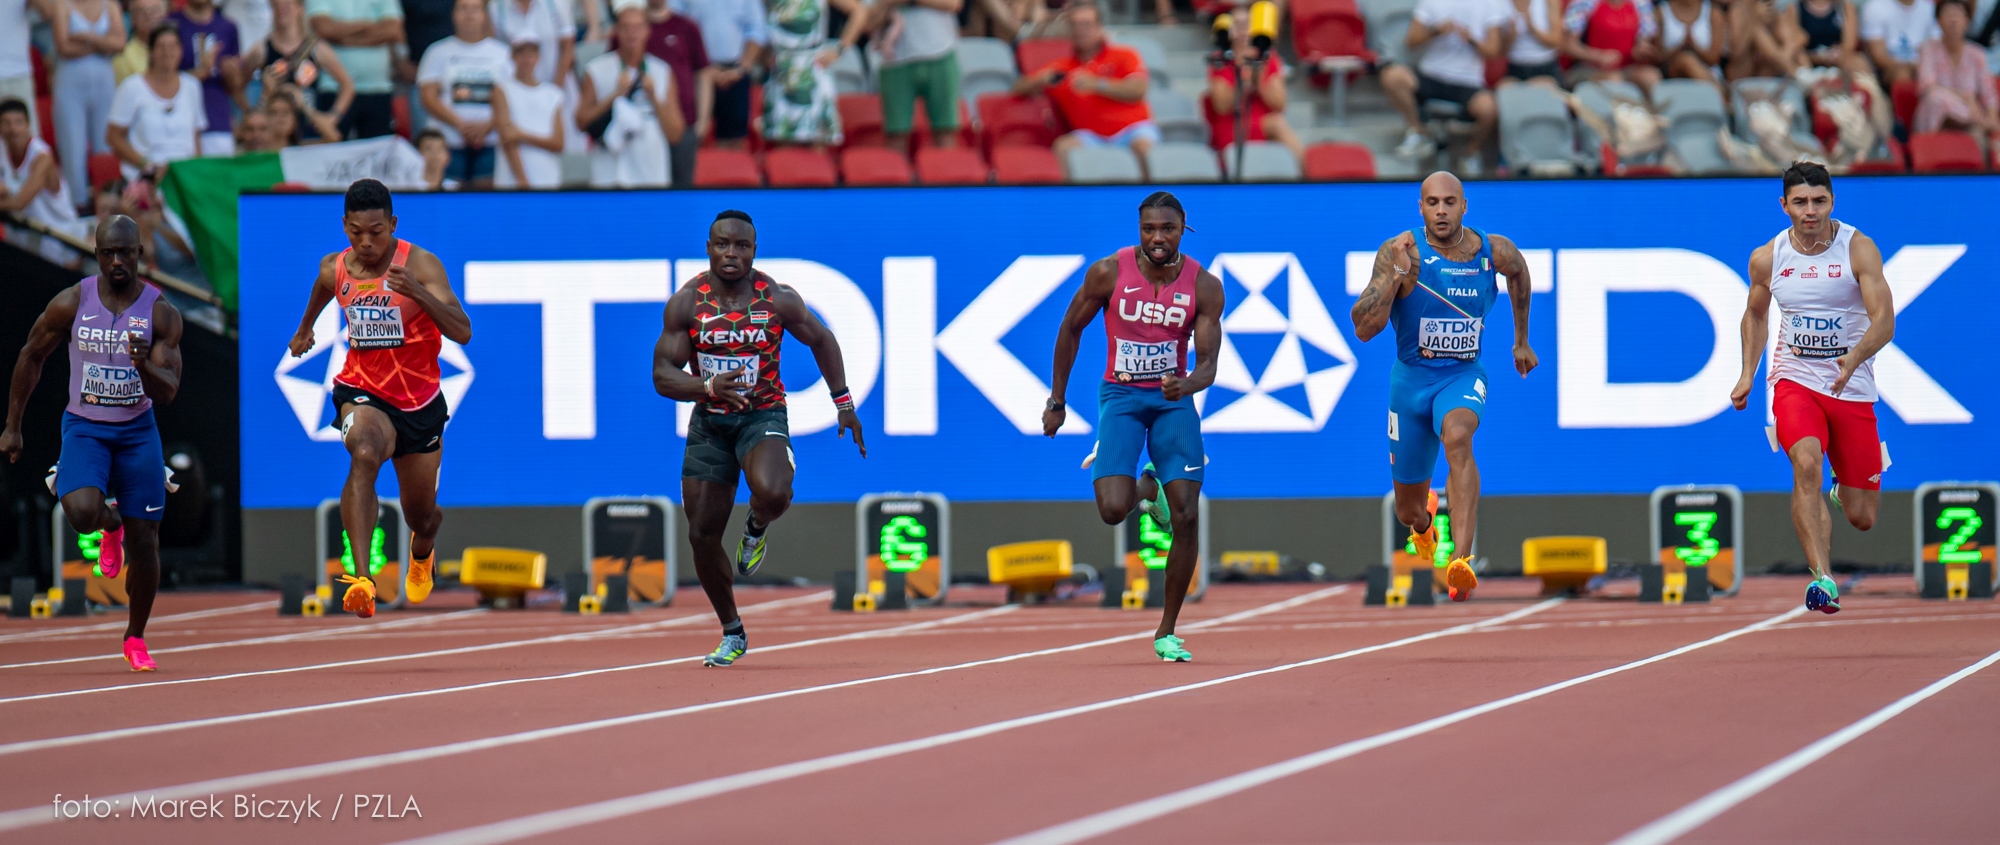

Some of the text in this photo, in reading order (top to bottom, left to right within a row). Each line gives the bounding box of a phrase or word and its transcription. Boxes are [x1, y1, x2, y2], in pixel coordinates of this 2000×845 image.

[1780, 268, 1795, 277] 4F
[1447, 287, 1478, 297] ITALIA
[356, 307, 398, 321] TDK
[1119, 298, 1187, 327] USA
[365, 323, 401, 336] BROWN
[1438, 320, 1478, 333] TDK
[1802, 316, 1843, 331] TDK
[700, 328, 767, 345] KENYA
[1345, 243, 1974, 430] DK
[1422, 334, 1477, 350] JACOBS
[1793, 332, 1839, 348] KOPEĆ
[77, 340, 130, 355] BRITA
[464, 254, 1093, 441] TDK
[1132, 341, 1173, 357] TDK
[1803, 349, 1836, 357] BUDAPEST
[713, 357, 755, 371] TDK
[1125, 357, 1168, 372] LYLES
[100, 367, 140, 381] TDK
[84, 378, 141, 397] AMO-DADZIE
[1674, 512, 1719, 567] 3
[1936, 507, 1983, 564] 2
[880, 515, 928, 573] 6
